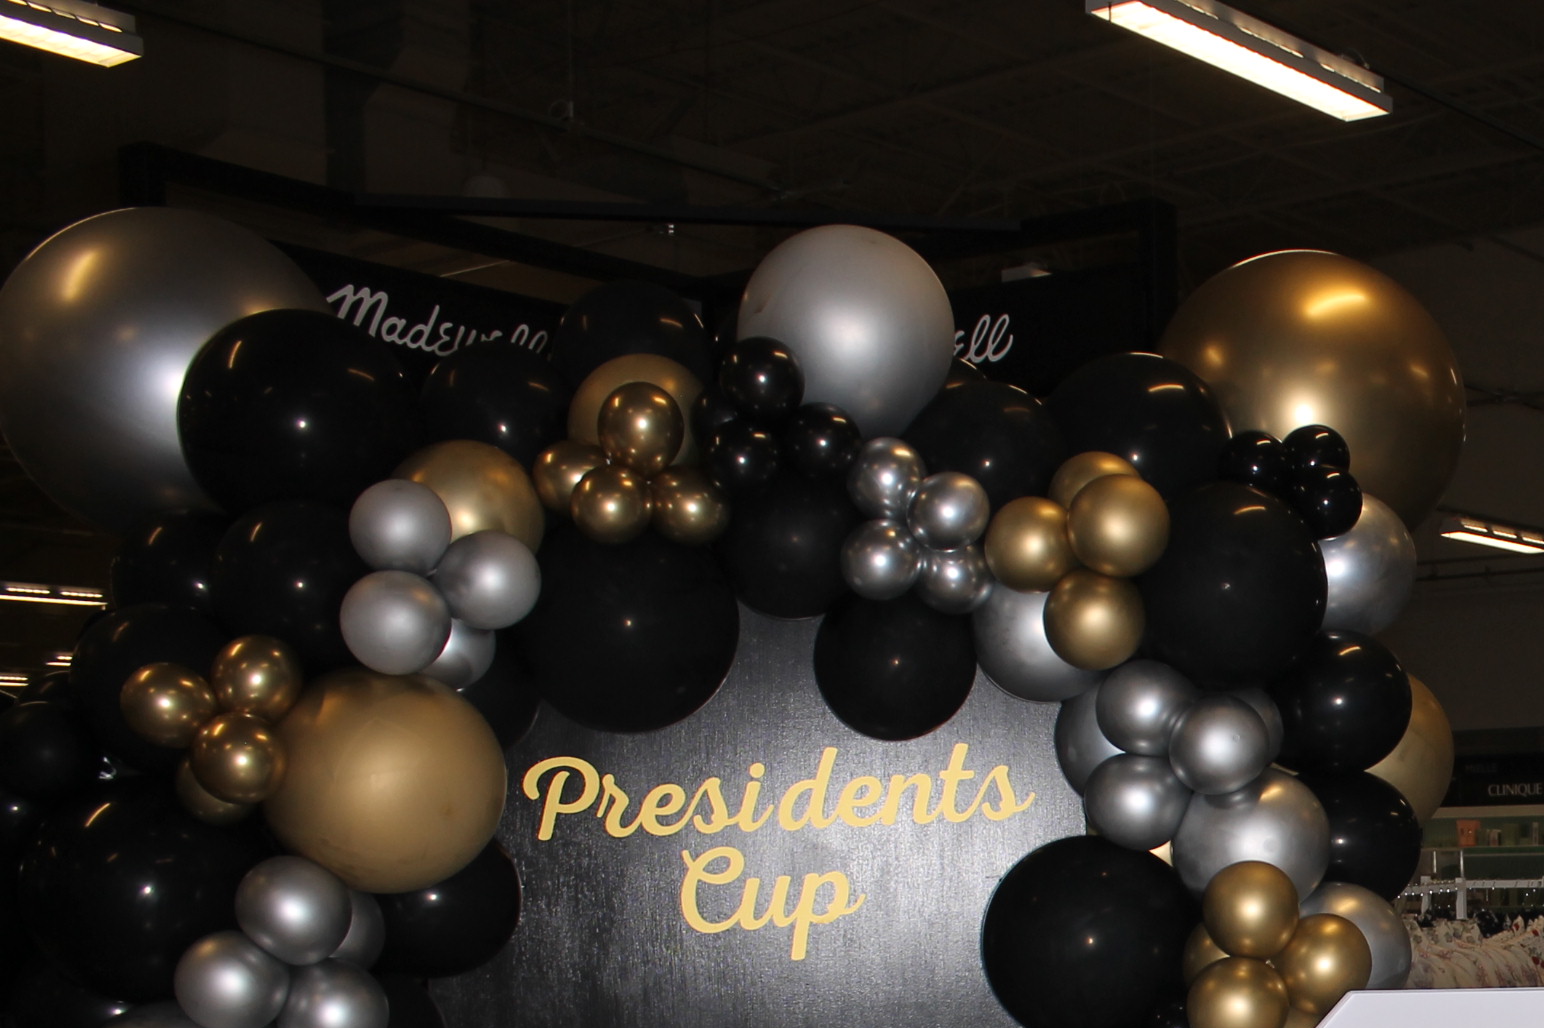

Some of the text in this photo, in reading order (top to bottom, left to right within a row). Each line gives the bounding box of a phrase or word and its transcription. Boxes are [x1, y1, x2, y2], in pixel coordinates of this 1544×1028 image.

[522, 743, 1036, 841] Presidents
[1487, 782, 1543, 797] CLINIQUE
[681, 846, 866, 960] Cup
